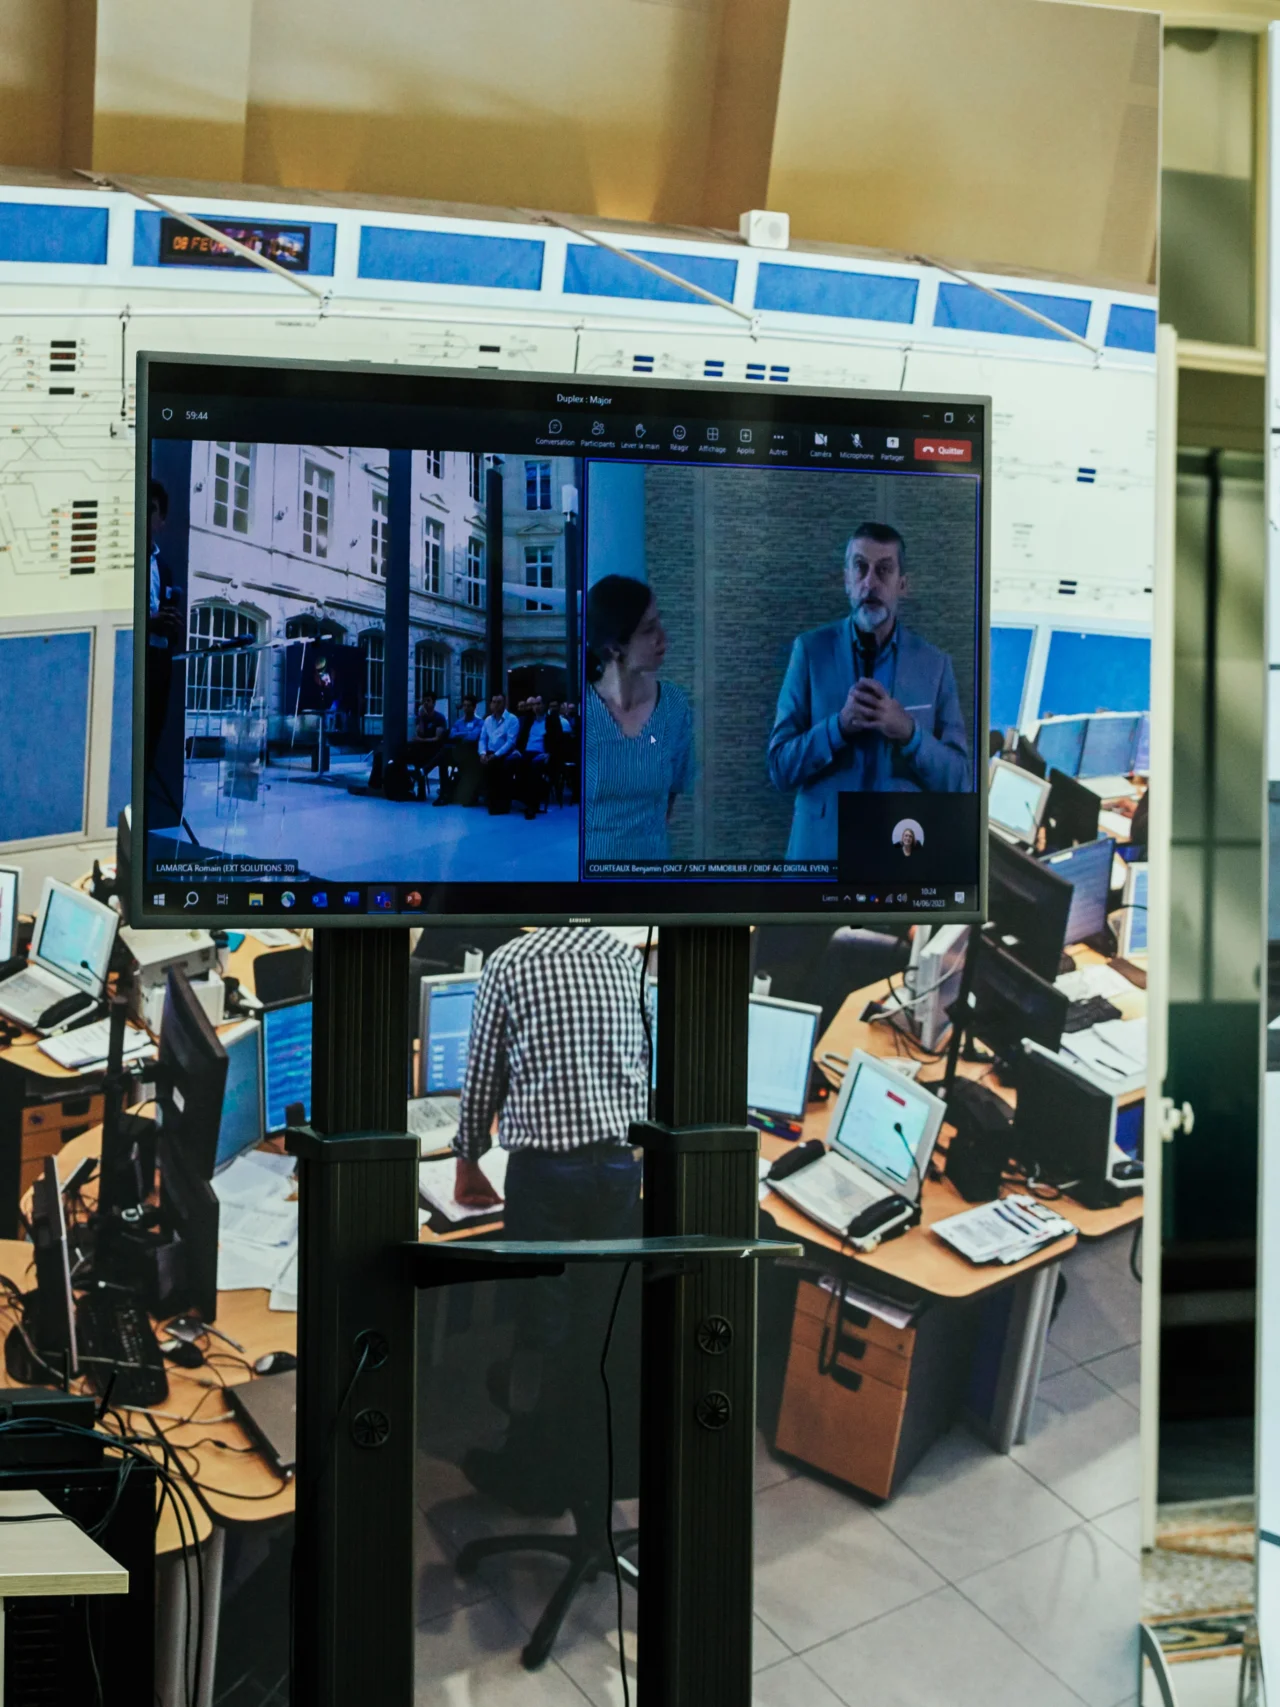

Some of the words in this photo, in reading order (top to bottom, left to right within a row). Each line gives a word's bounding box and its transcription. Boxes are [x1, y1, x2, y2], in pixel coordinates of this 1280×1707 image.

[556, 394, 583, 405] Duplex
[589, 395, 612, 407] Major
[185, 410, 208, 421] 59:44
[535, 437, 575, 447] Conversation
[580, 439, 616, 449] Participants
[620, 440, 637, 449] Lever
[644, 442, 660, 450] main
[669, 442, 689, 453] Réagir
[698, 444, 726, 455] Affichage
[769, 448, 788, 457] Autres
[938, 446, 964, 456] Quitter
[809, 449, 833, 459] Caméra
[839, 451, 874, 461] Microphone
[880, 453, 905, 463] Partager
[156, 864, 192, 872] LAMARCA
[194, 864, 221, 872] Romain
[222, 864, 239, 874] (EXT
[240, 864, 282, 872] SOLUTIONS
[283, 864, 295, 874] 30)
[589, 864, 630, 872] COURTEAUX
[631, 864, 662, 874] Benjamin
[662, 864, 682, 873] (SNCF
[689, 864, 706, 872] SNCF
[707, 864, 748, 873] IMMOBILIER
[772, 864, 782, 873] AG
[783, 864, 808, 873] DIGITAL
[809, 864, 829, 874] EVEN)
[822, 894, 838, 902] Liens
